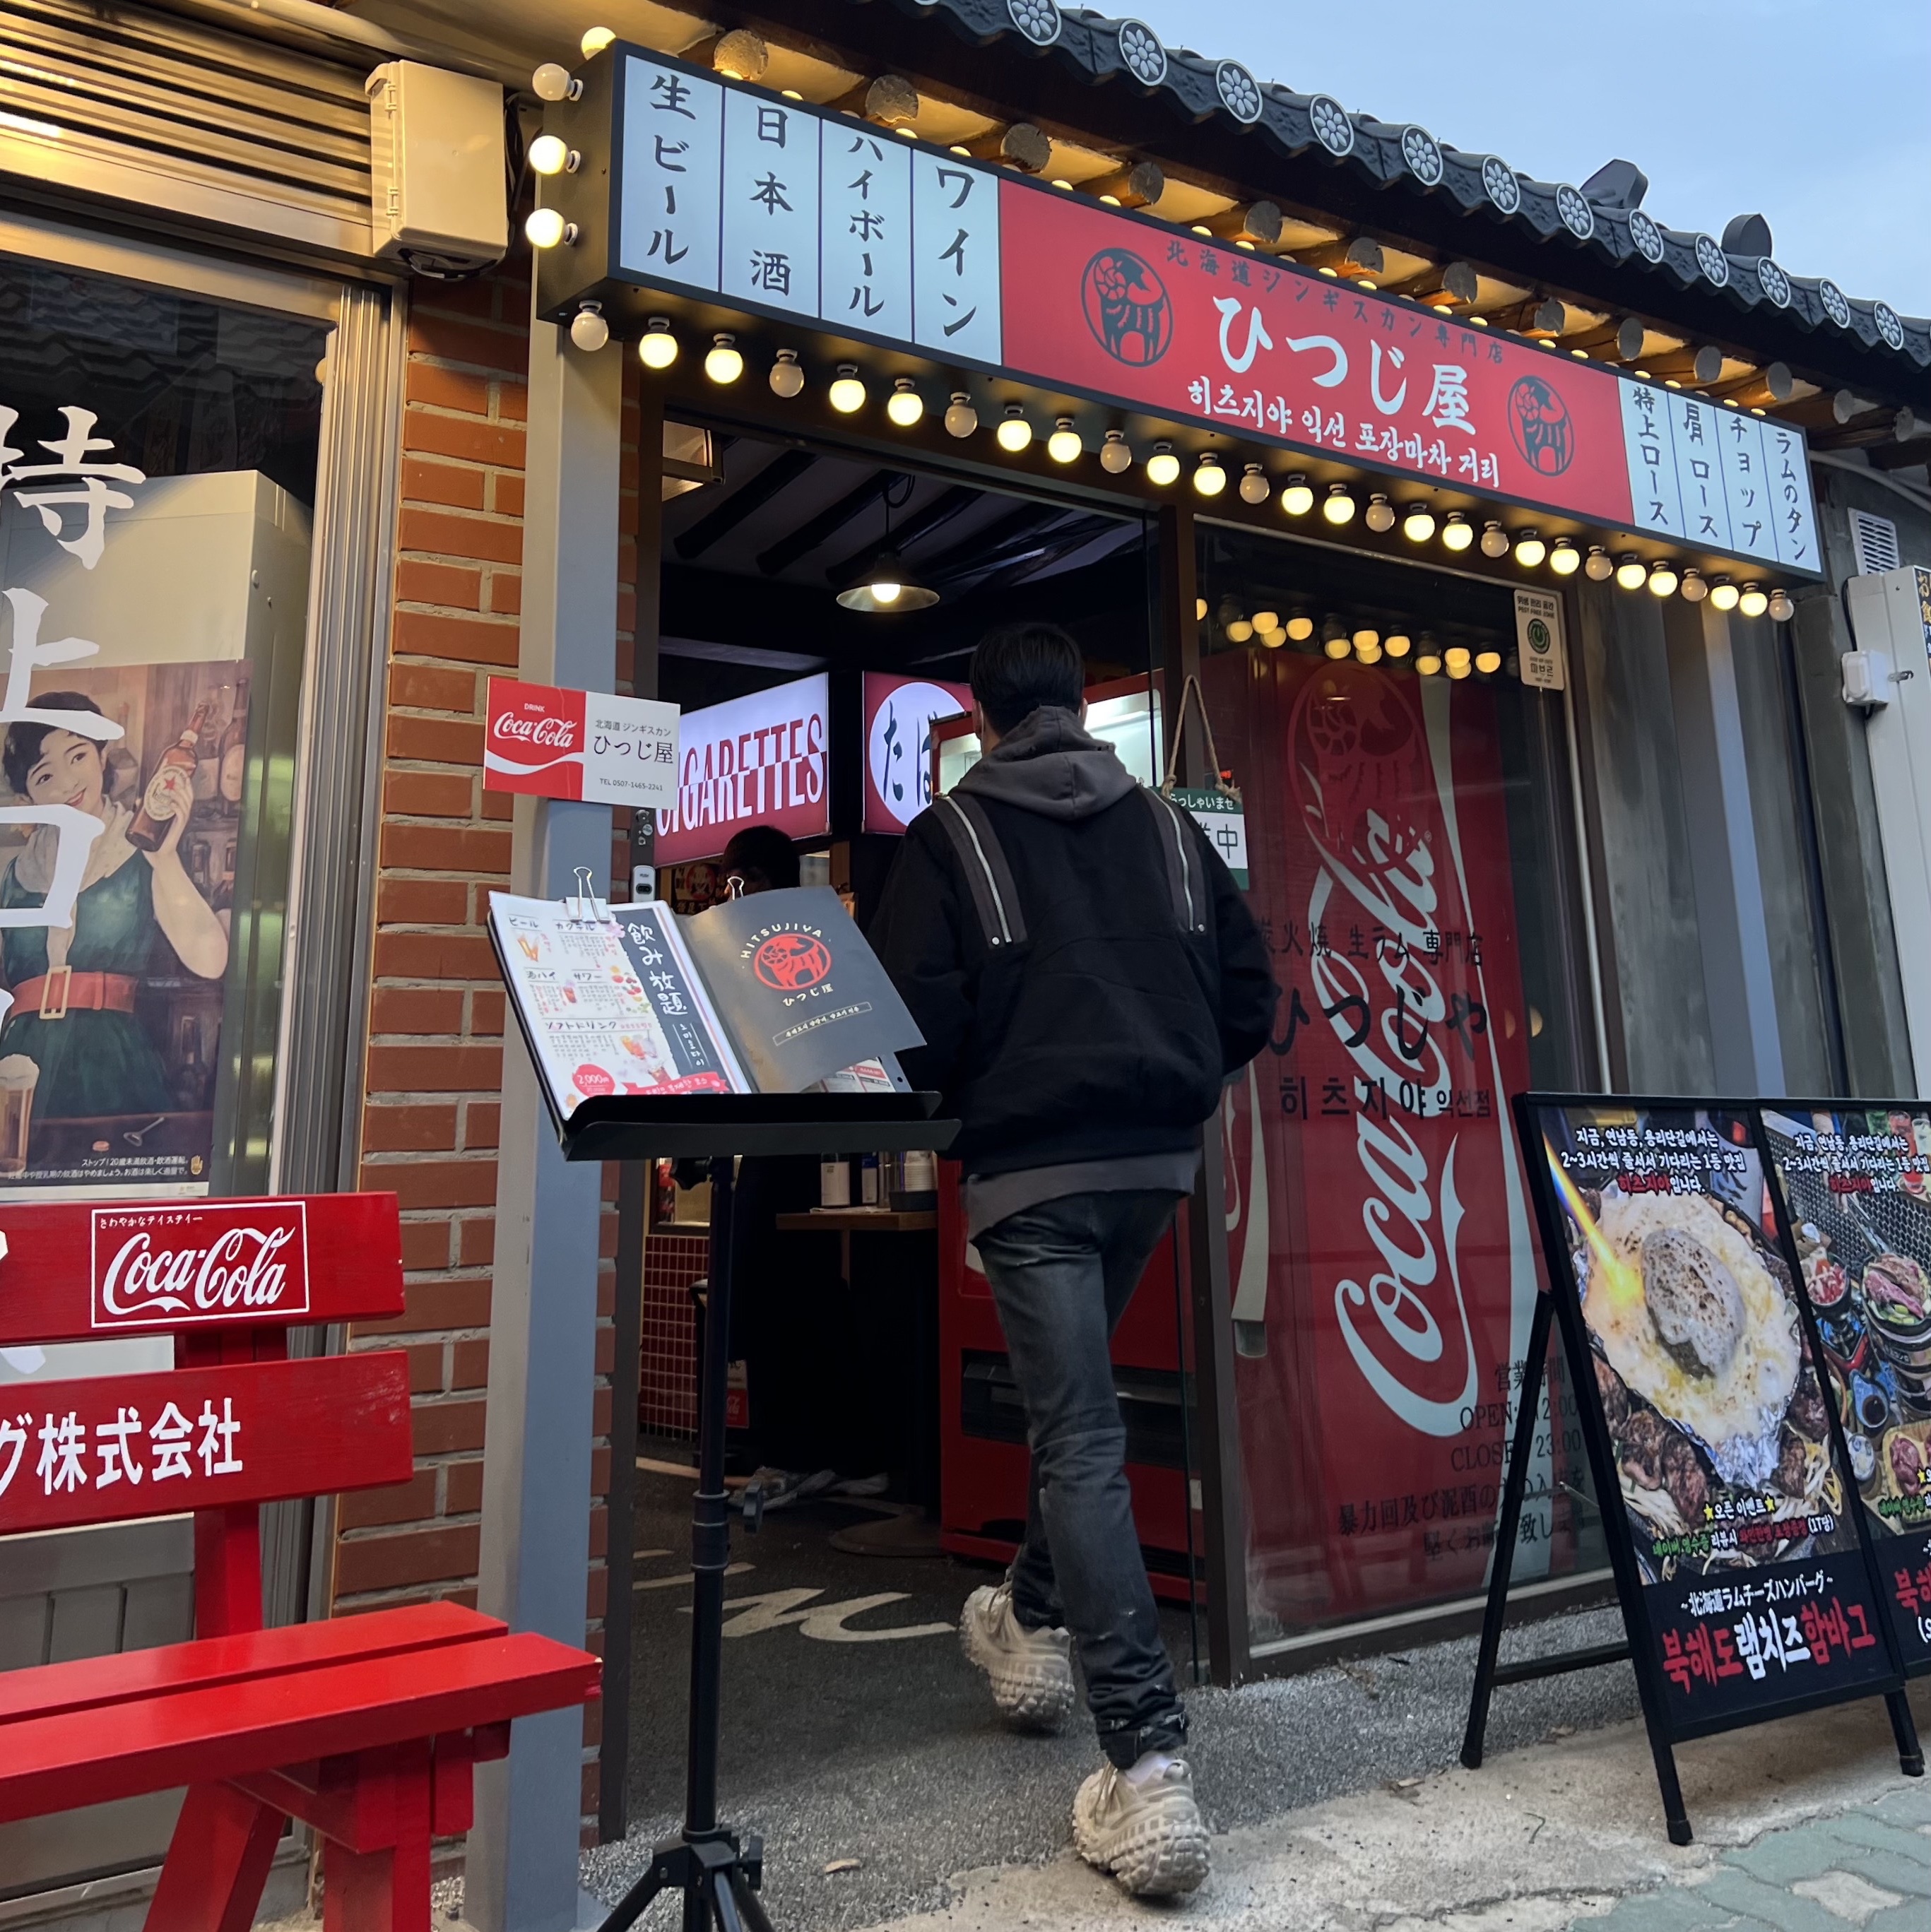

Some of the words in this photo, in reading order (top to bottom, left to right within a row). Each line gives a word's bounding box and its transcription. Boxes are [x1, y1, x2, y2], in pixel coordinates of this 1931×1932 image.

[647, 74, 696, 265] 生ビール
[750, 105, 793, 296] 日本酒
[848, 136, 885, 317] ハイボール
[936, 167, 976, 337] ワイン
[1212, 296, 1476, 435] ひつじ屋
[1188, 375, 1293, 434] 히츠지야
[1301, 405, 1346, 448] 익선
[1354, 422, 1452, 475] 포장마차
[1458, 453, 1499, 488] 거리
[1633, 386, 1668, 525] 特上ロース
[1730, 417, 1761, 547] チョップ
[1776, 432, 1807, 561] ラムのタン
[524, 703, 545, 713] DRINK
[594, 735, 673, 764] ひつじ屋
[596, 719, 620, 732] 北海道
[622, 722, 671, 737] ジンギスカン
[600, 778, 612, 786] TEL
[627, 921, 688, 1016] 飲み放題
[740, 923, 822, 959] HITSUJIYA
[1280, 1076, 1427, 1121] 히츠지야
[1660, 1151, 1701, 1171] 기다리는
[1714, 1502, 1735, 1520] 오픈
[1736, 1496, 1766, 1518] 이벤트
